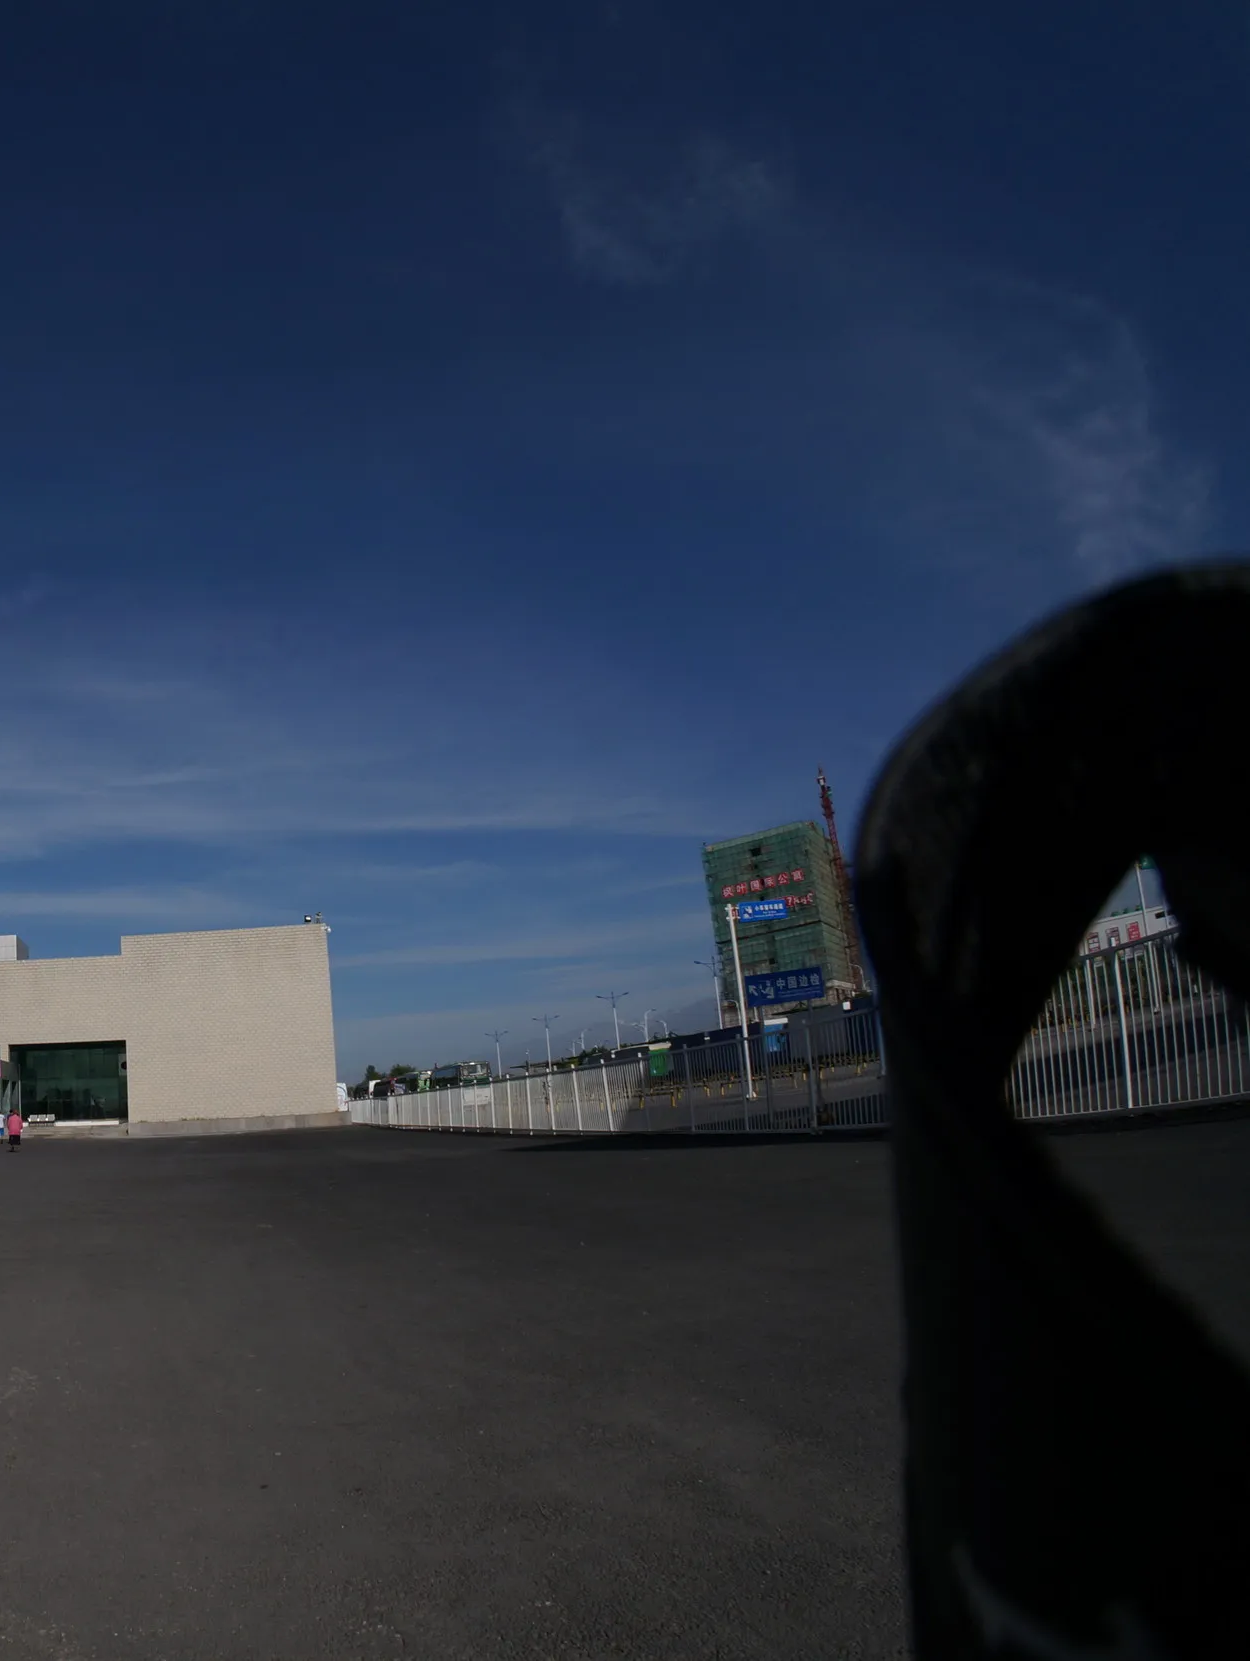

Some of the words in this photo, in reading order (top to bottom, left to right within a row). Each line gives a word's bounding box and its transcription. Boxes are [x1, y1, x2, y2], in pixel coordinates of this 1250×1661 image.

[722, 868, 805, 899] 枫叶国际公寓
[776, 973, 820, 990] 中国边检
